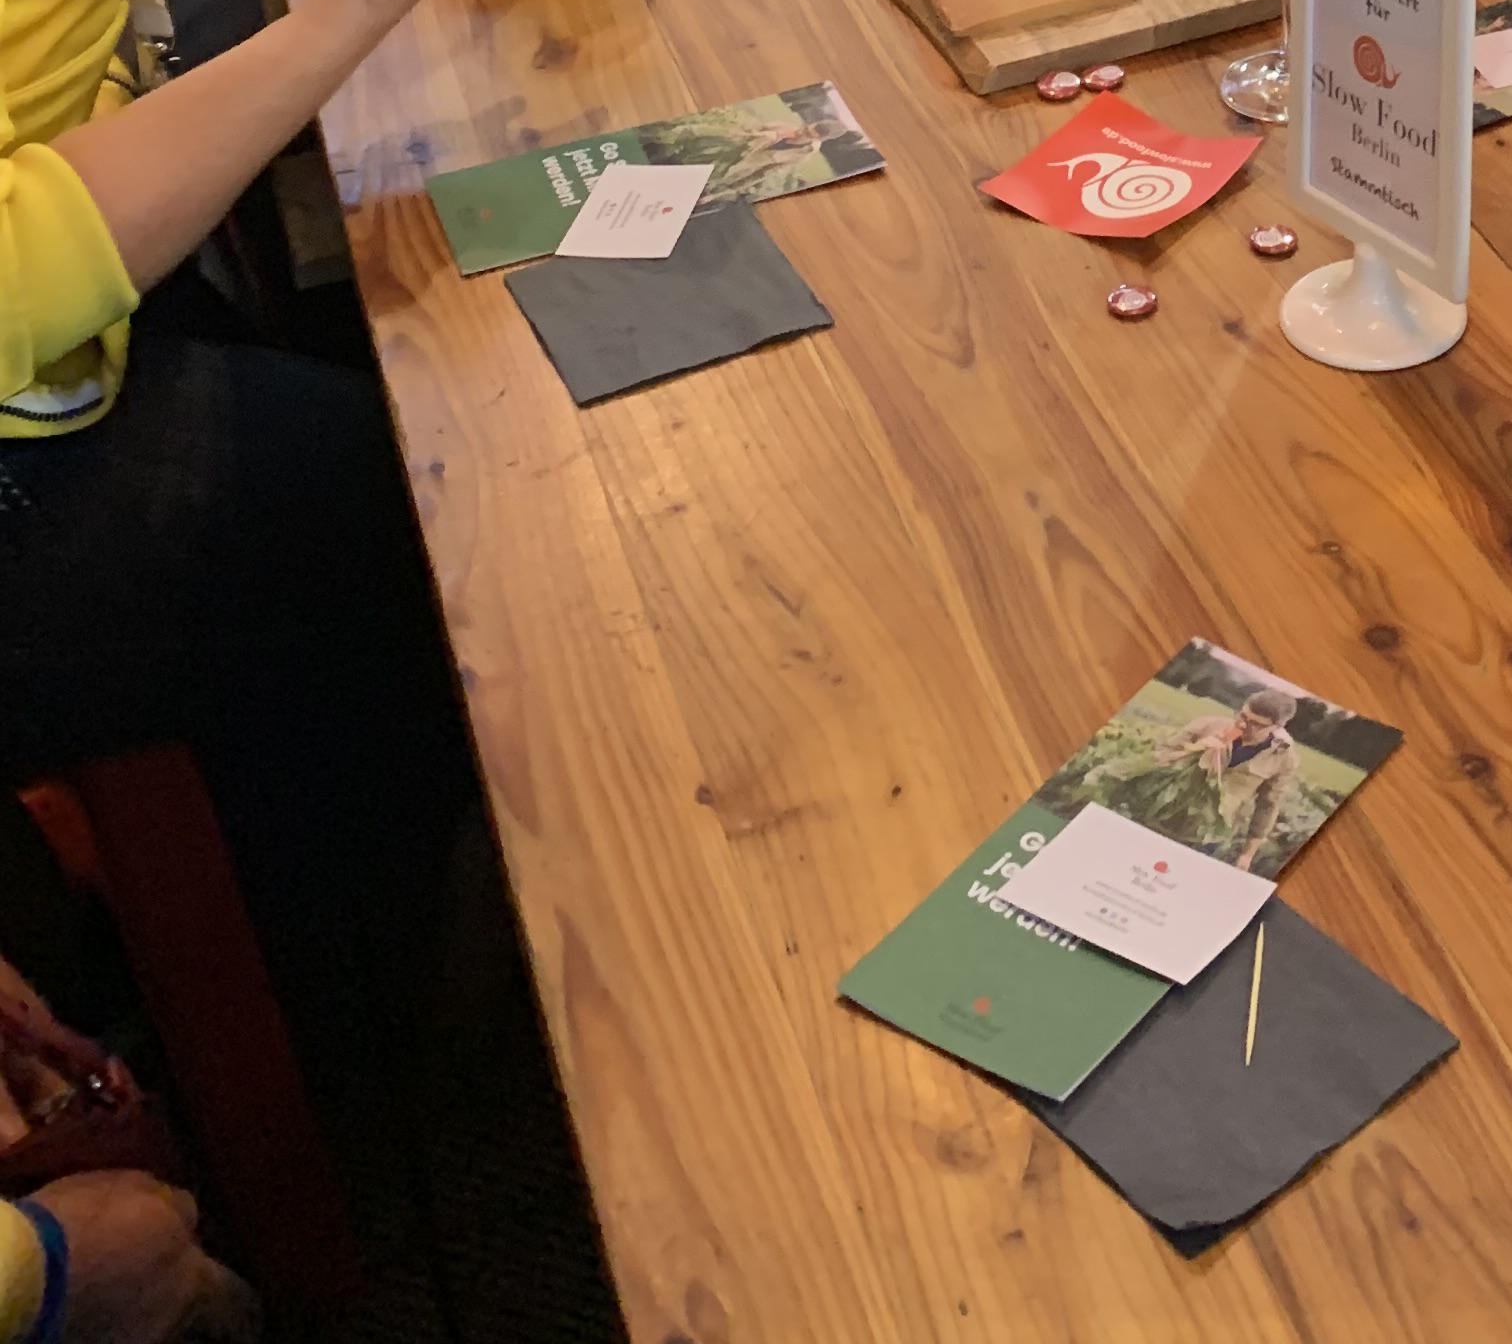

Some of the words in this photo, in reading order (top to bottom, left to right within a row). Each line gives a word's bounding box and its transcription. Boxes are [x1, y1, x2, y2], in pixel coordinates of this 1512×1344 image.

[1312, 63, 1368, 116] Slow
[1376, 97, 1437, 158] Food
[1351, 122, 1401, 168] Berlin
[1330, 155, 1420, 221] Stammtisch
